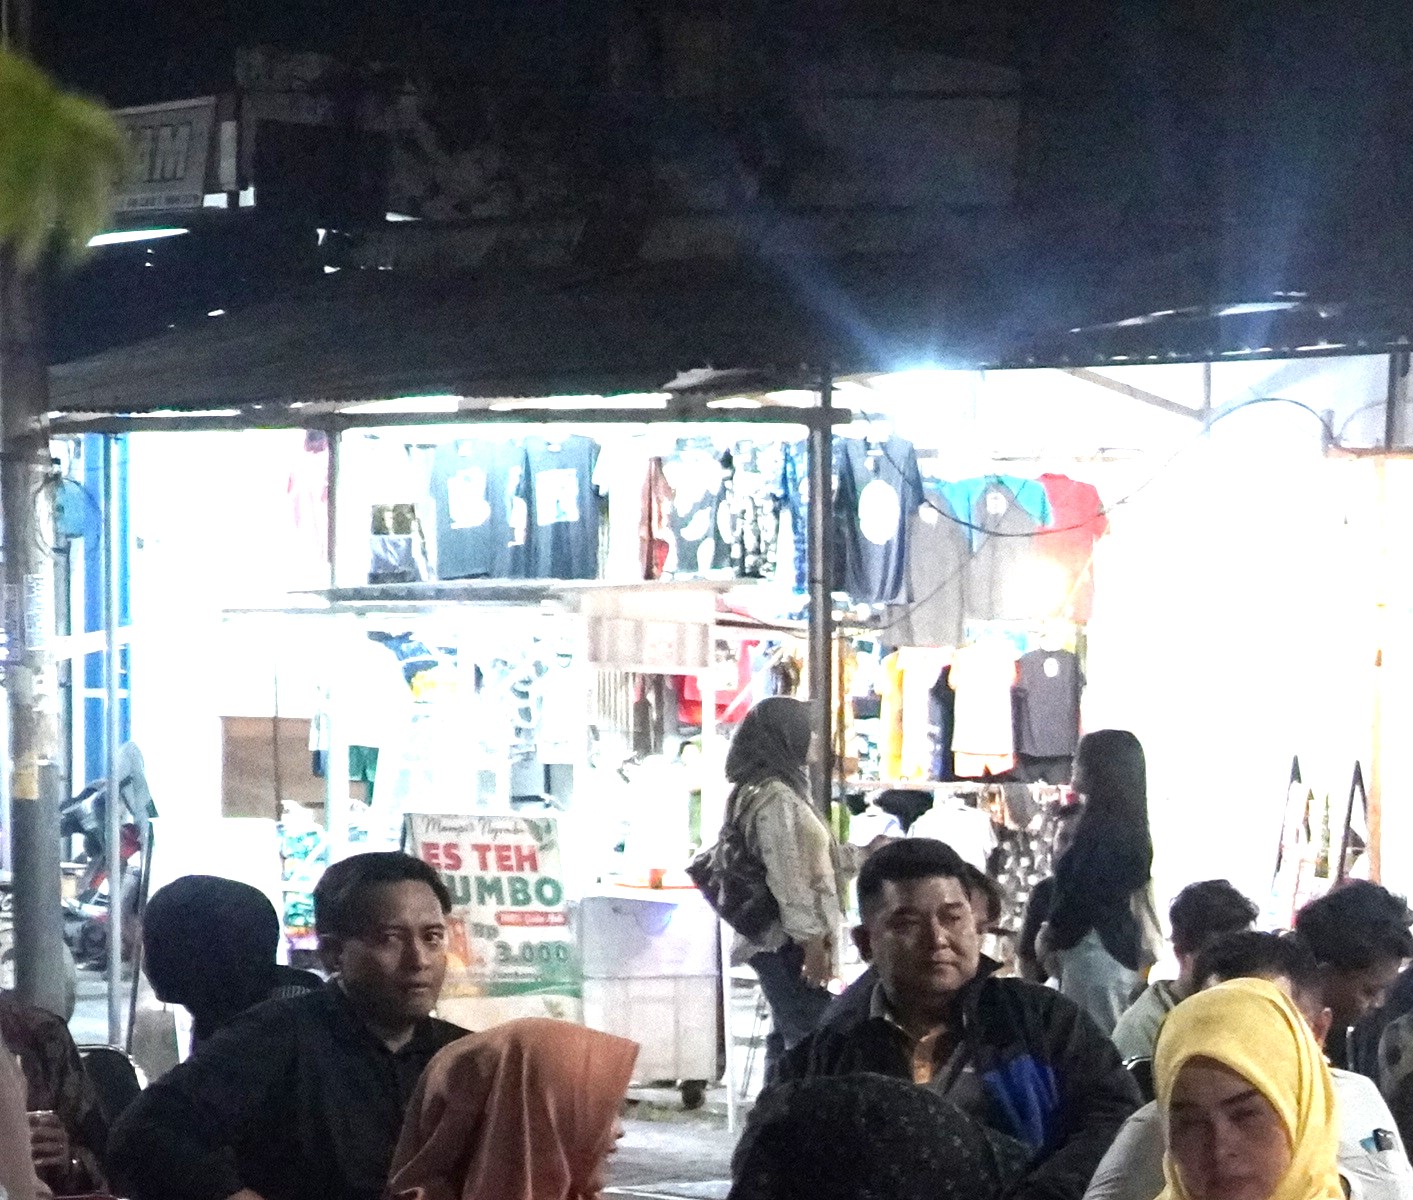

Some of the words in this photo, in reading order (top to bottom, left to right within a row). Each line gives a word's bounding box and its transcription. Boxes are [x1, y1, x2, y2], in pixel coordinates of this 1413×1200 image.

[421, 842, 462, 871] ES
[471, 844, 539, 872] TEH
[440, 874, 563, 907] UMBO
